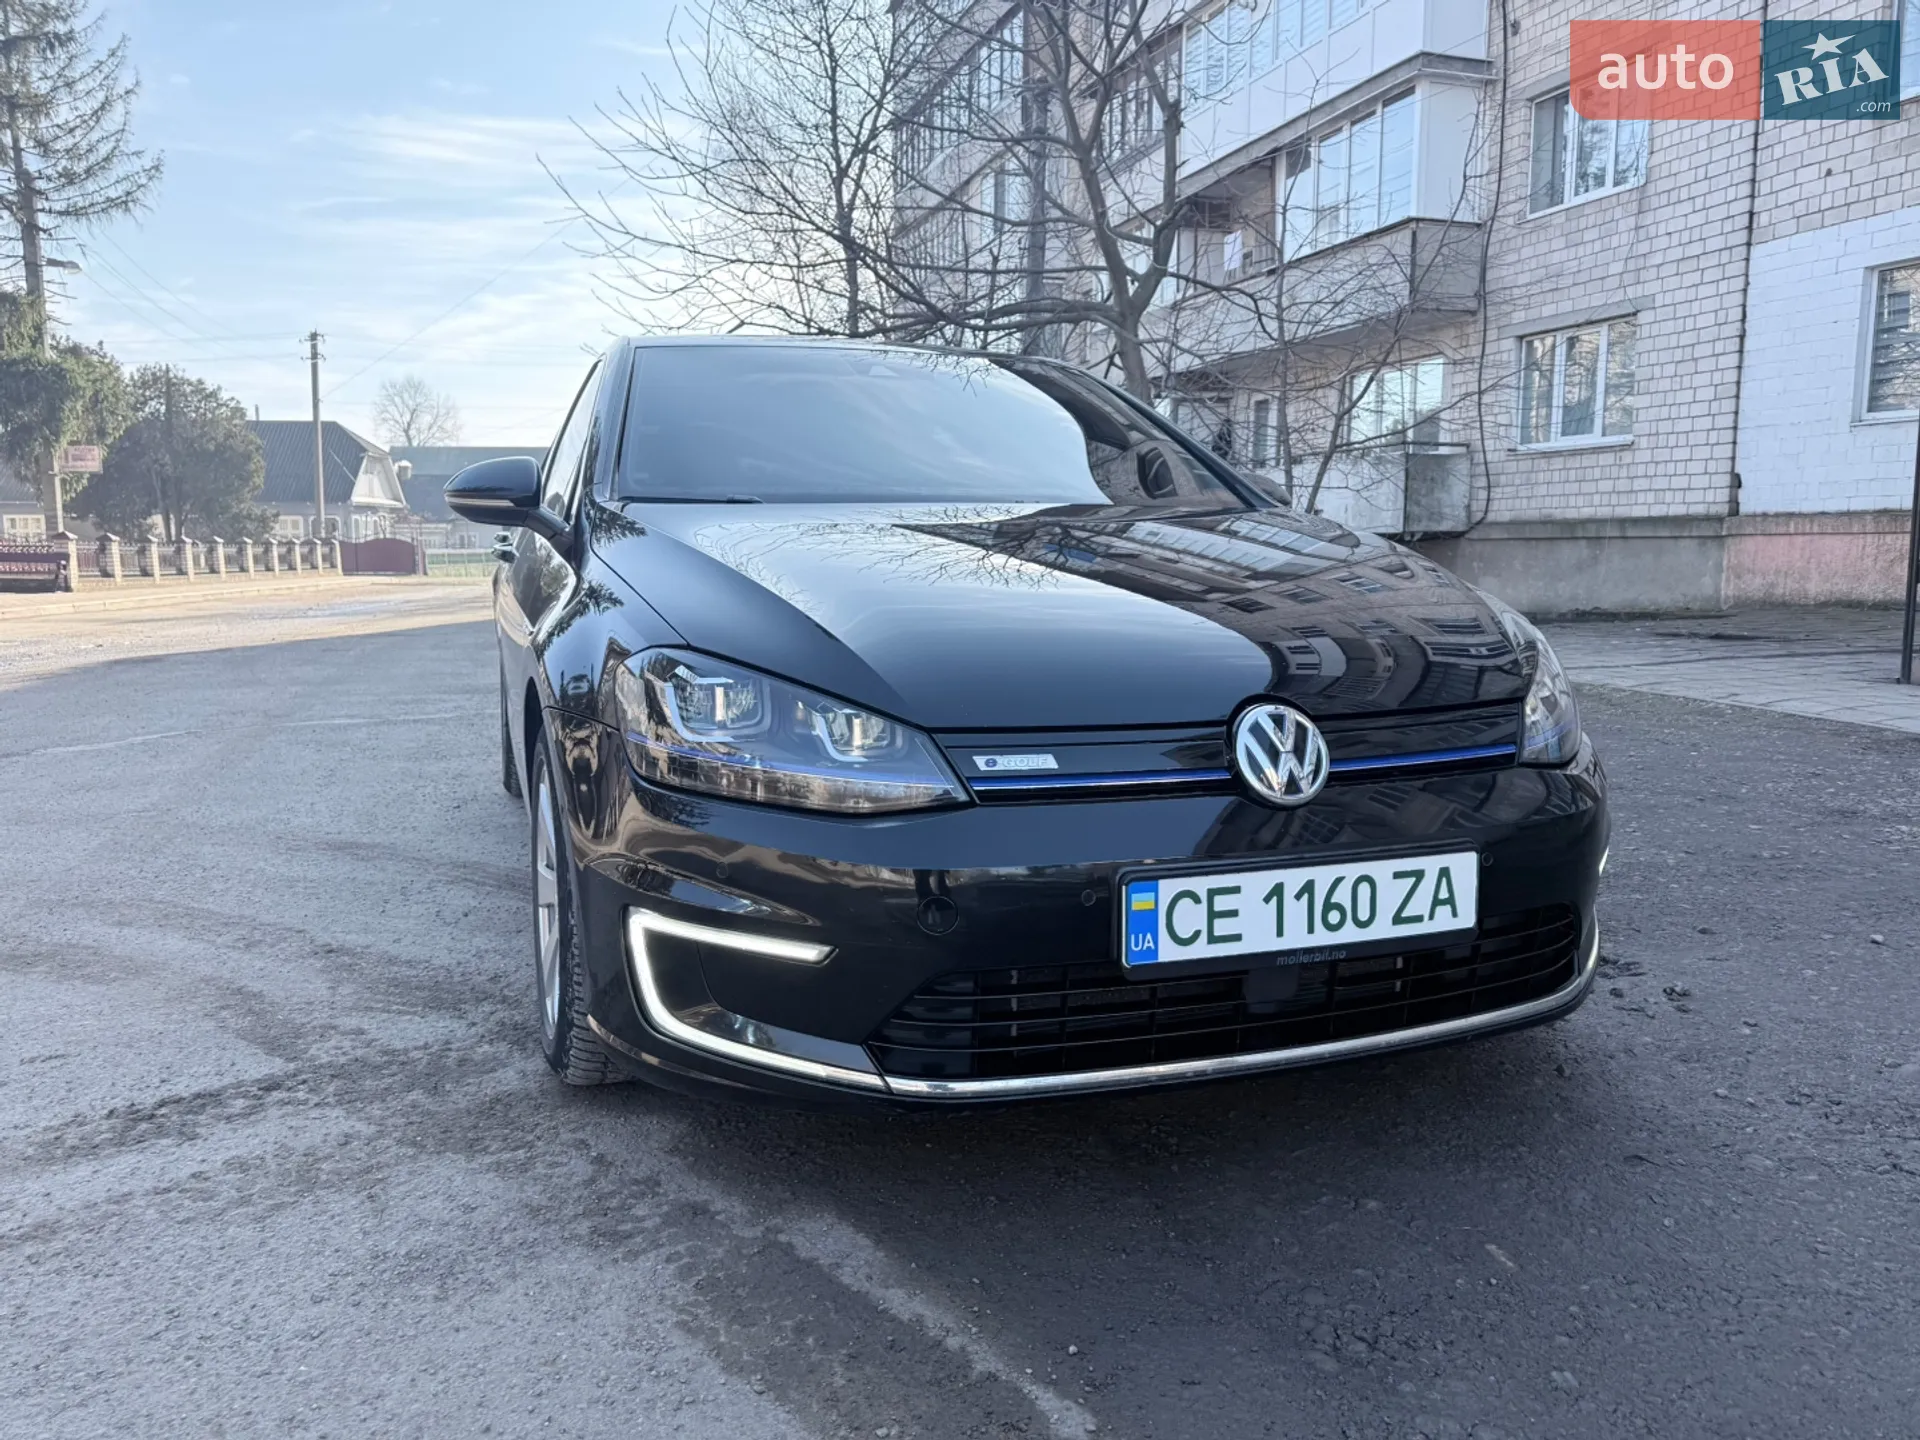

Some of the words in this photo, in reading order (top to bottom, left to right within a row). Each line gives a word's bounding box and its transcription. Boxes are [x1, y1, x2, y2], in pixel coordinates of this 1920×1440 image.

[1164, 885, 1243, 947] CE
[1262, 874, 1377, 938] 1160
[1391, 866, 1459, 926] ZA
[1130, 932, 1155, 952] UA
